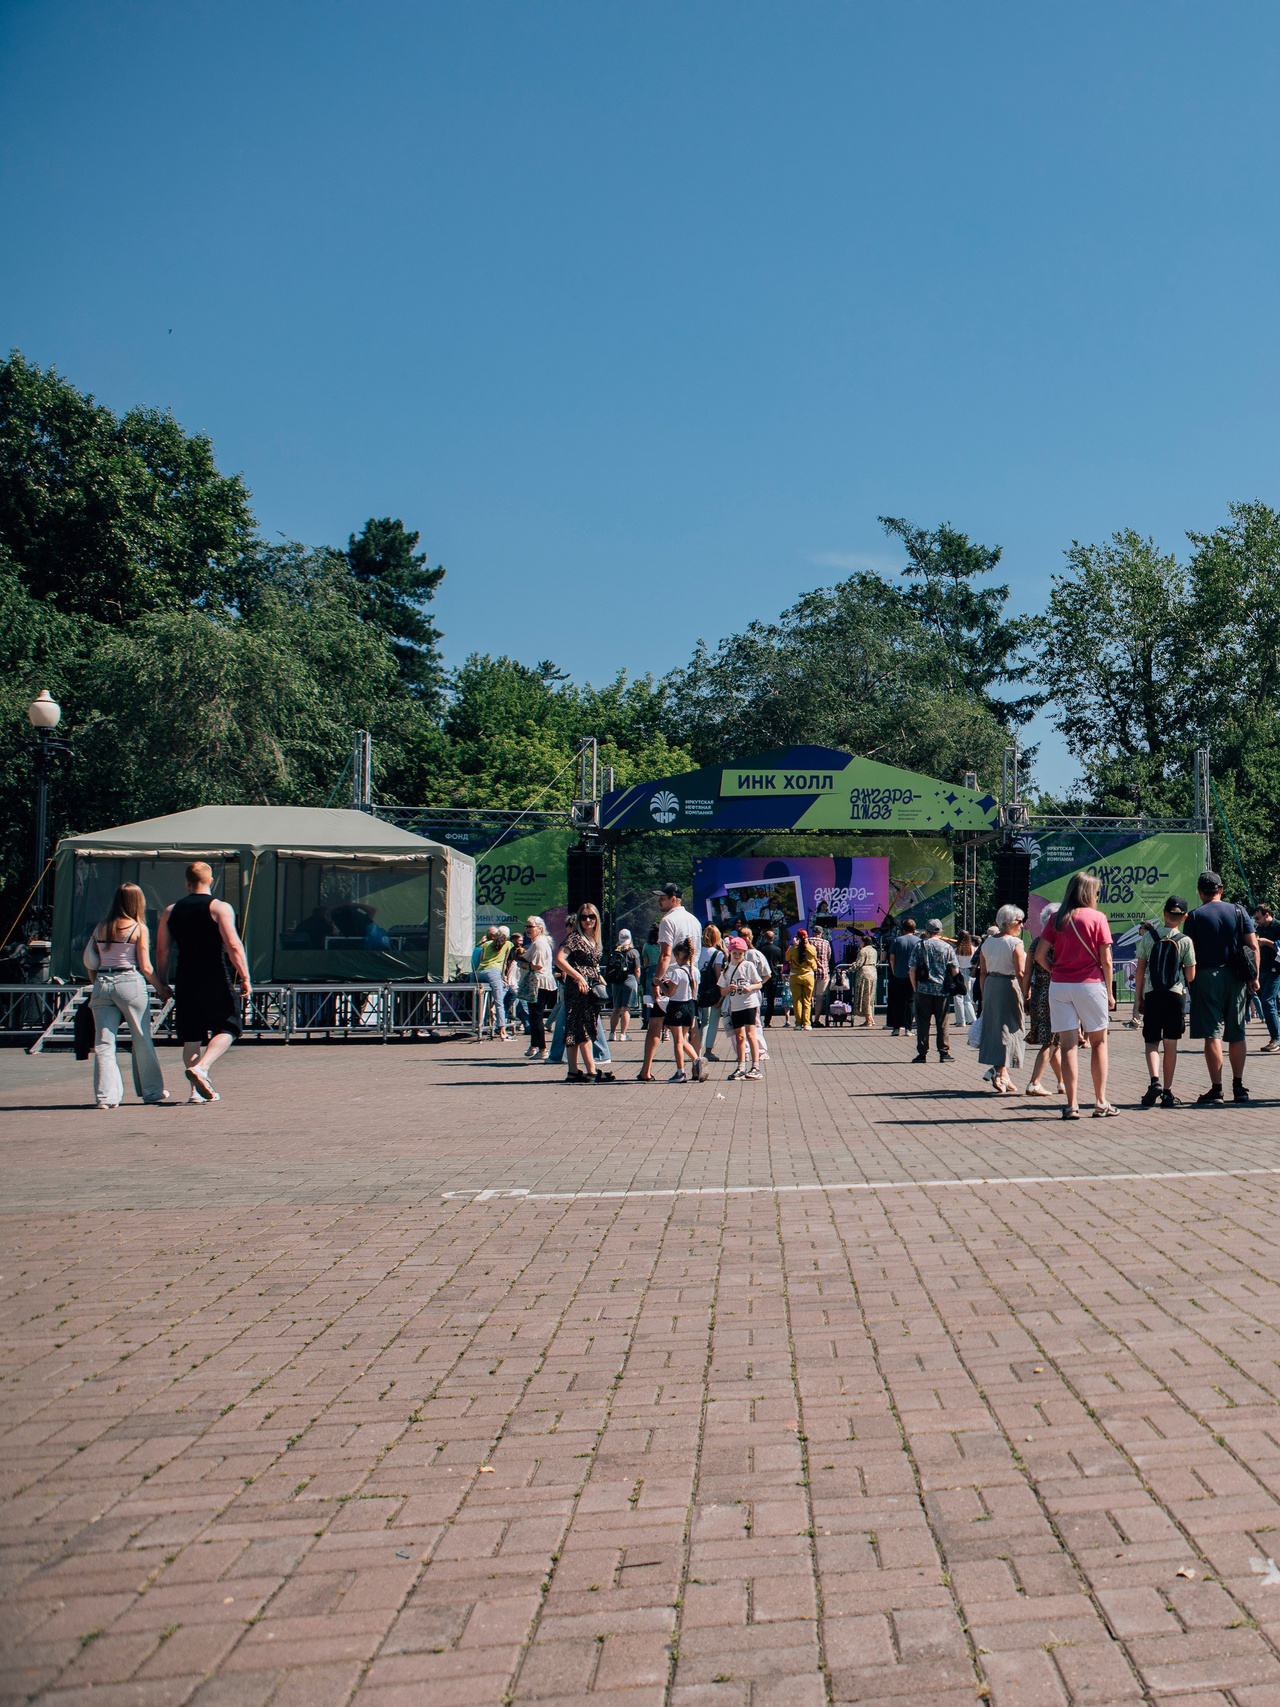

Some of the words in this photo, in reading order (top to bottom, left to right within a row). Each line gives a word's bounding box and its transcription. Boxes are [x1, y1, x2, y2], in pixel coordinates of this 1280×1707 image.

[737, 774, 777, 790] ИНК
[783, 774, 834, 790] ХОЛЛ
[445, 833, 469, 841] ФОНД
